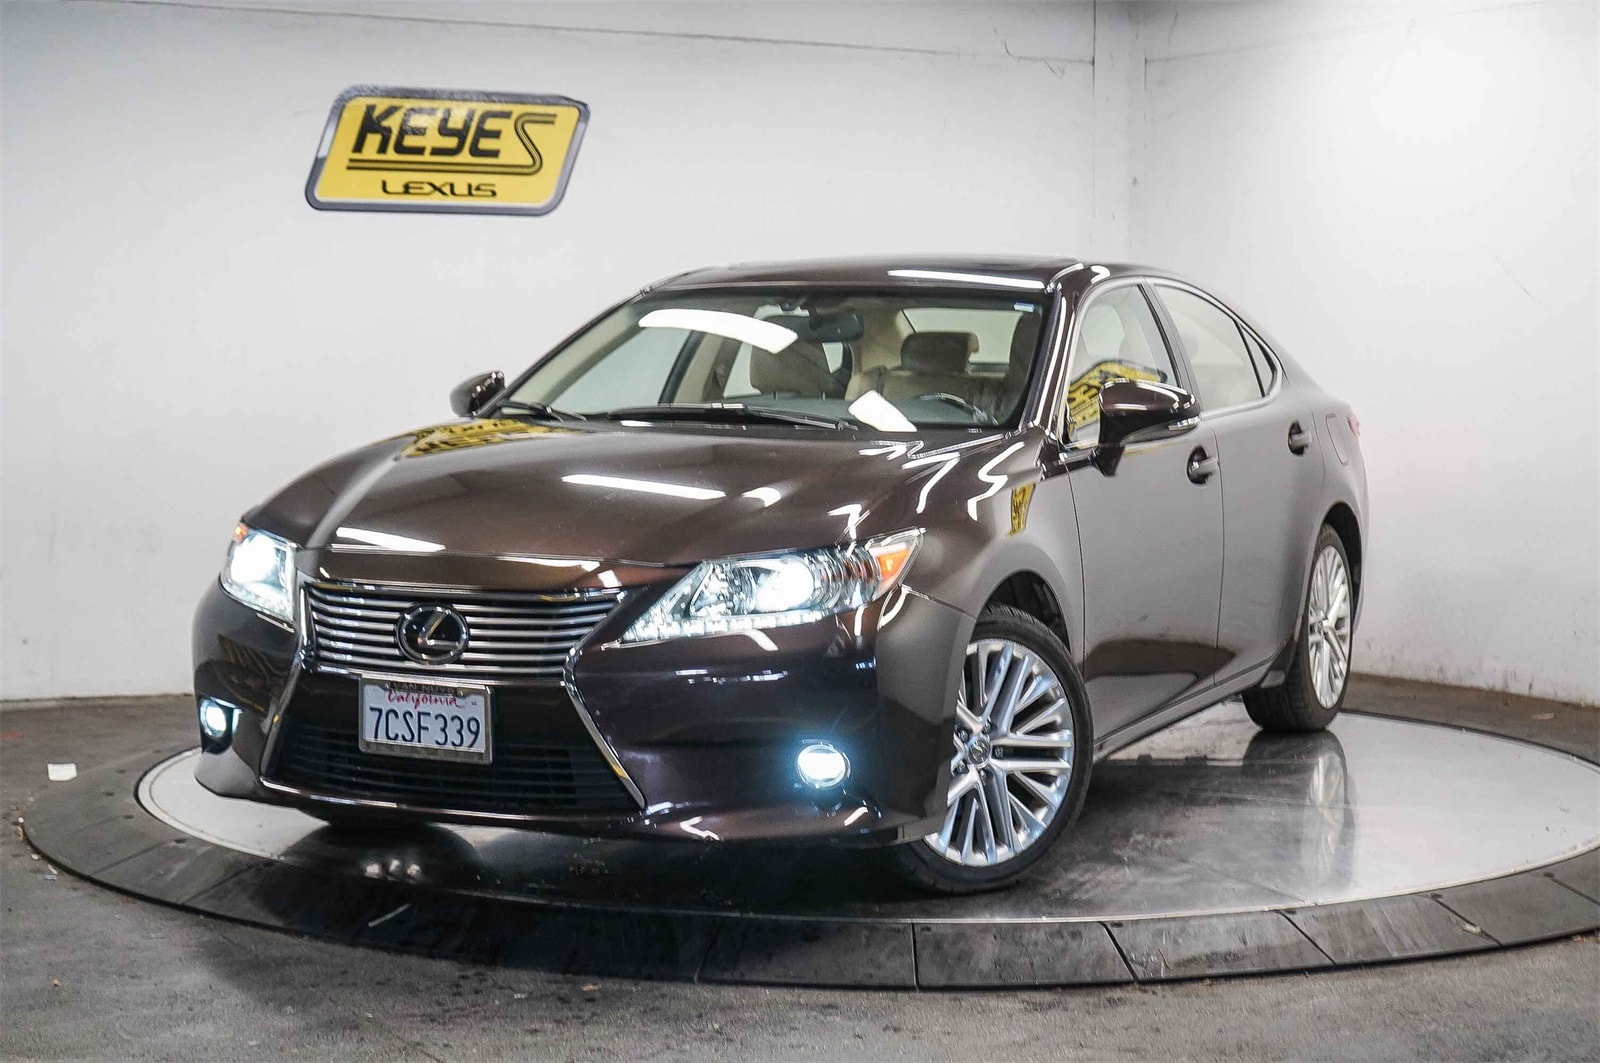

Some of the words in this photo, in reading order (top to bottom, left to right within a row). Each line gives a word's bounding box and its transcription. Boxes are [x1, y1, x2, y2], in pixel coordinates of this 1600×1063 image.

[350, 104, 558, 172] KEYES
[381, 180, 498, 197] LEXUS
[387, 690, 466, 709] California
[369, 706, 481, 748] 7CSF339
